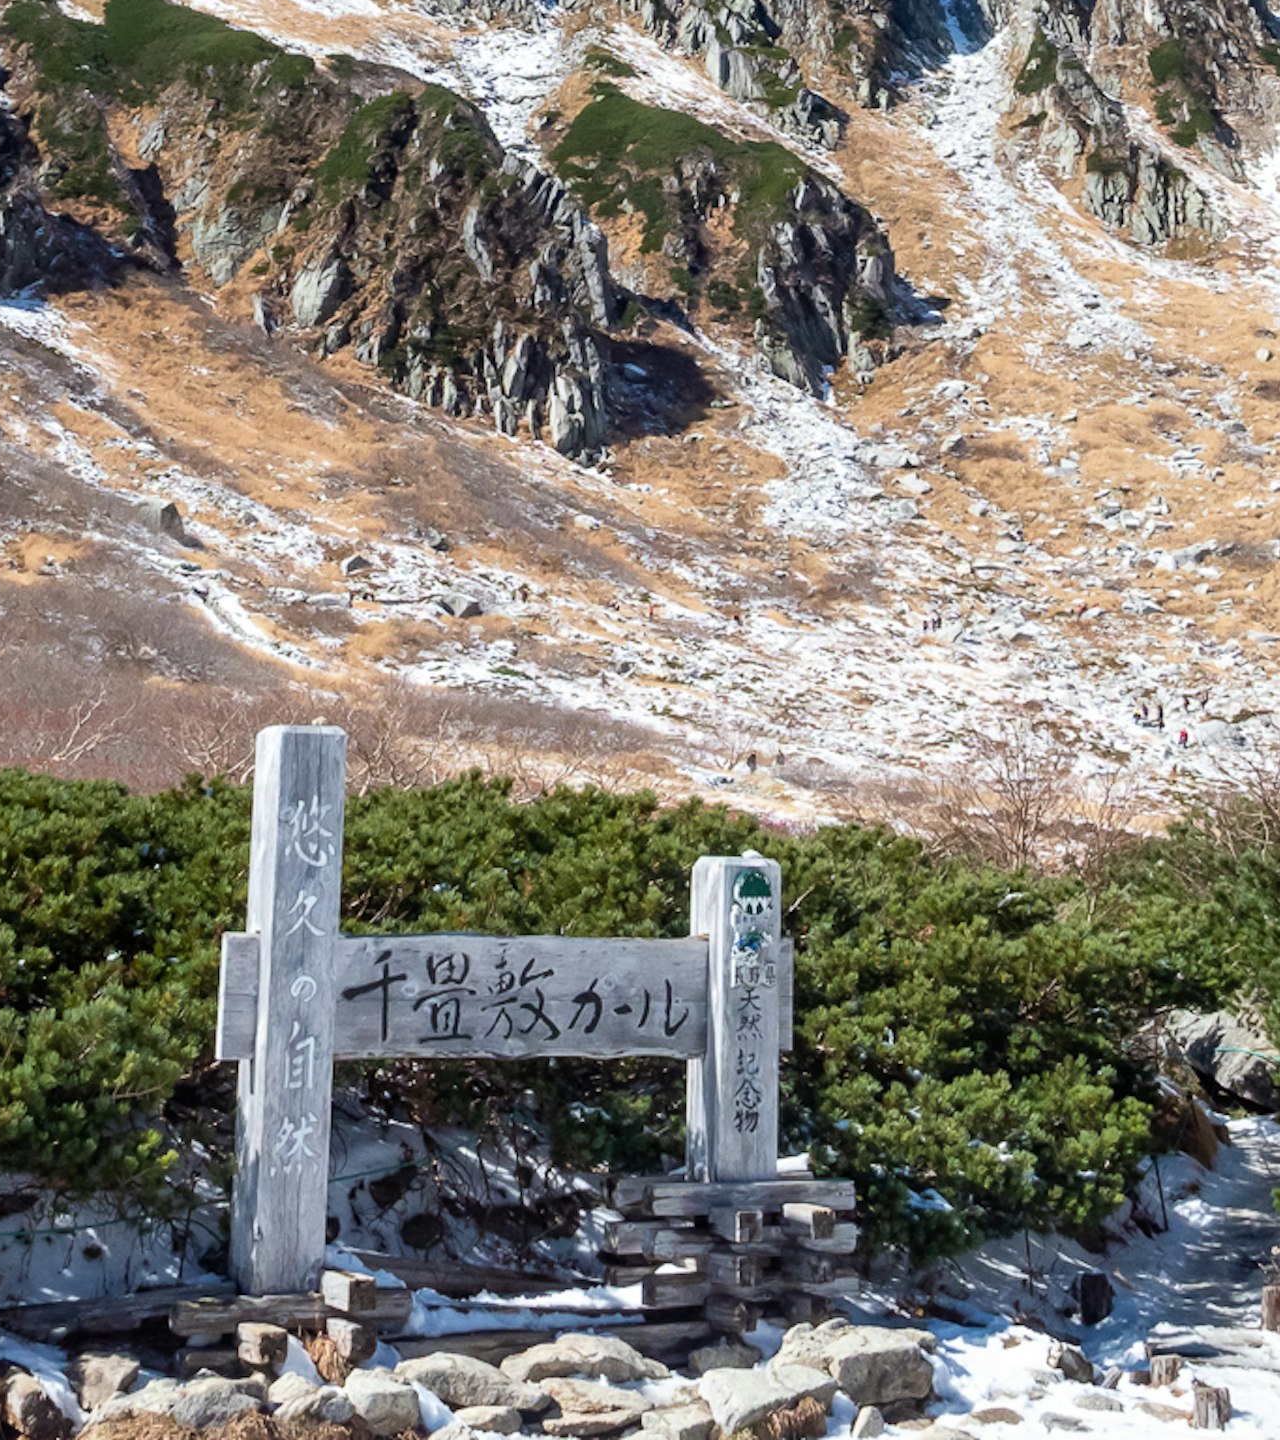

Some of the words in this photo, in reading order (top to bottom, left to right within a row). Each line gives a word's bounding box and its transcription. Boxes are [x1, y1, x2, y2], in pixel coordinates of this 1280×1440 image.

[272, 794, 335, 1175] 悠久の自然
[342, 942, 689, 1041] 千畳敷カール
[734, 988, 762, 1133] 天然記念物
